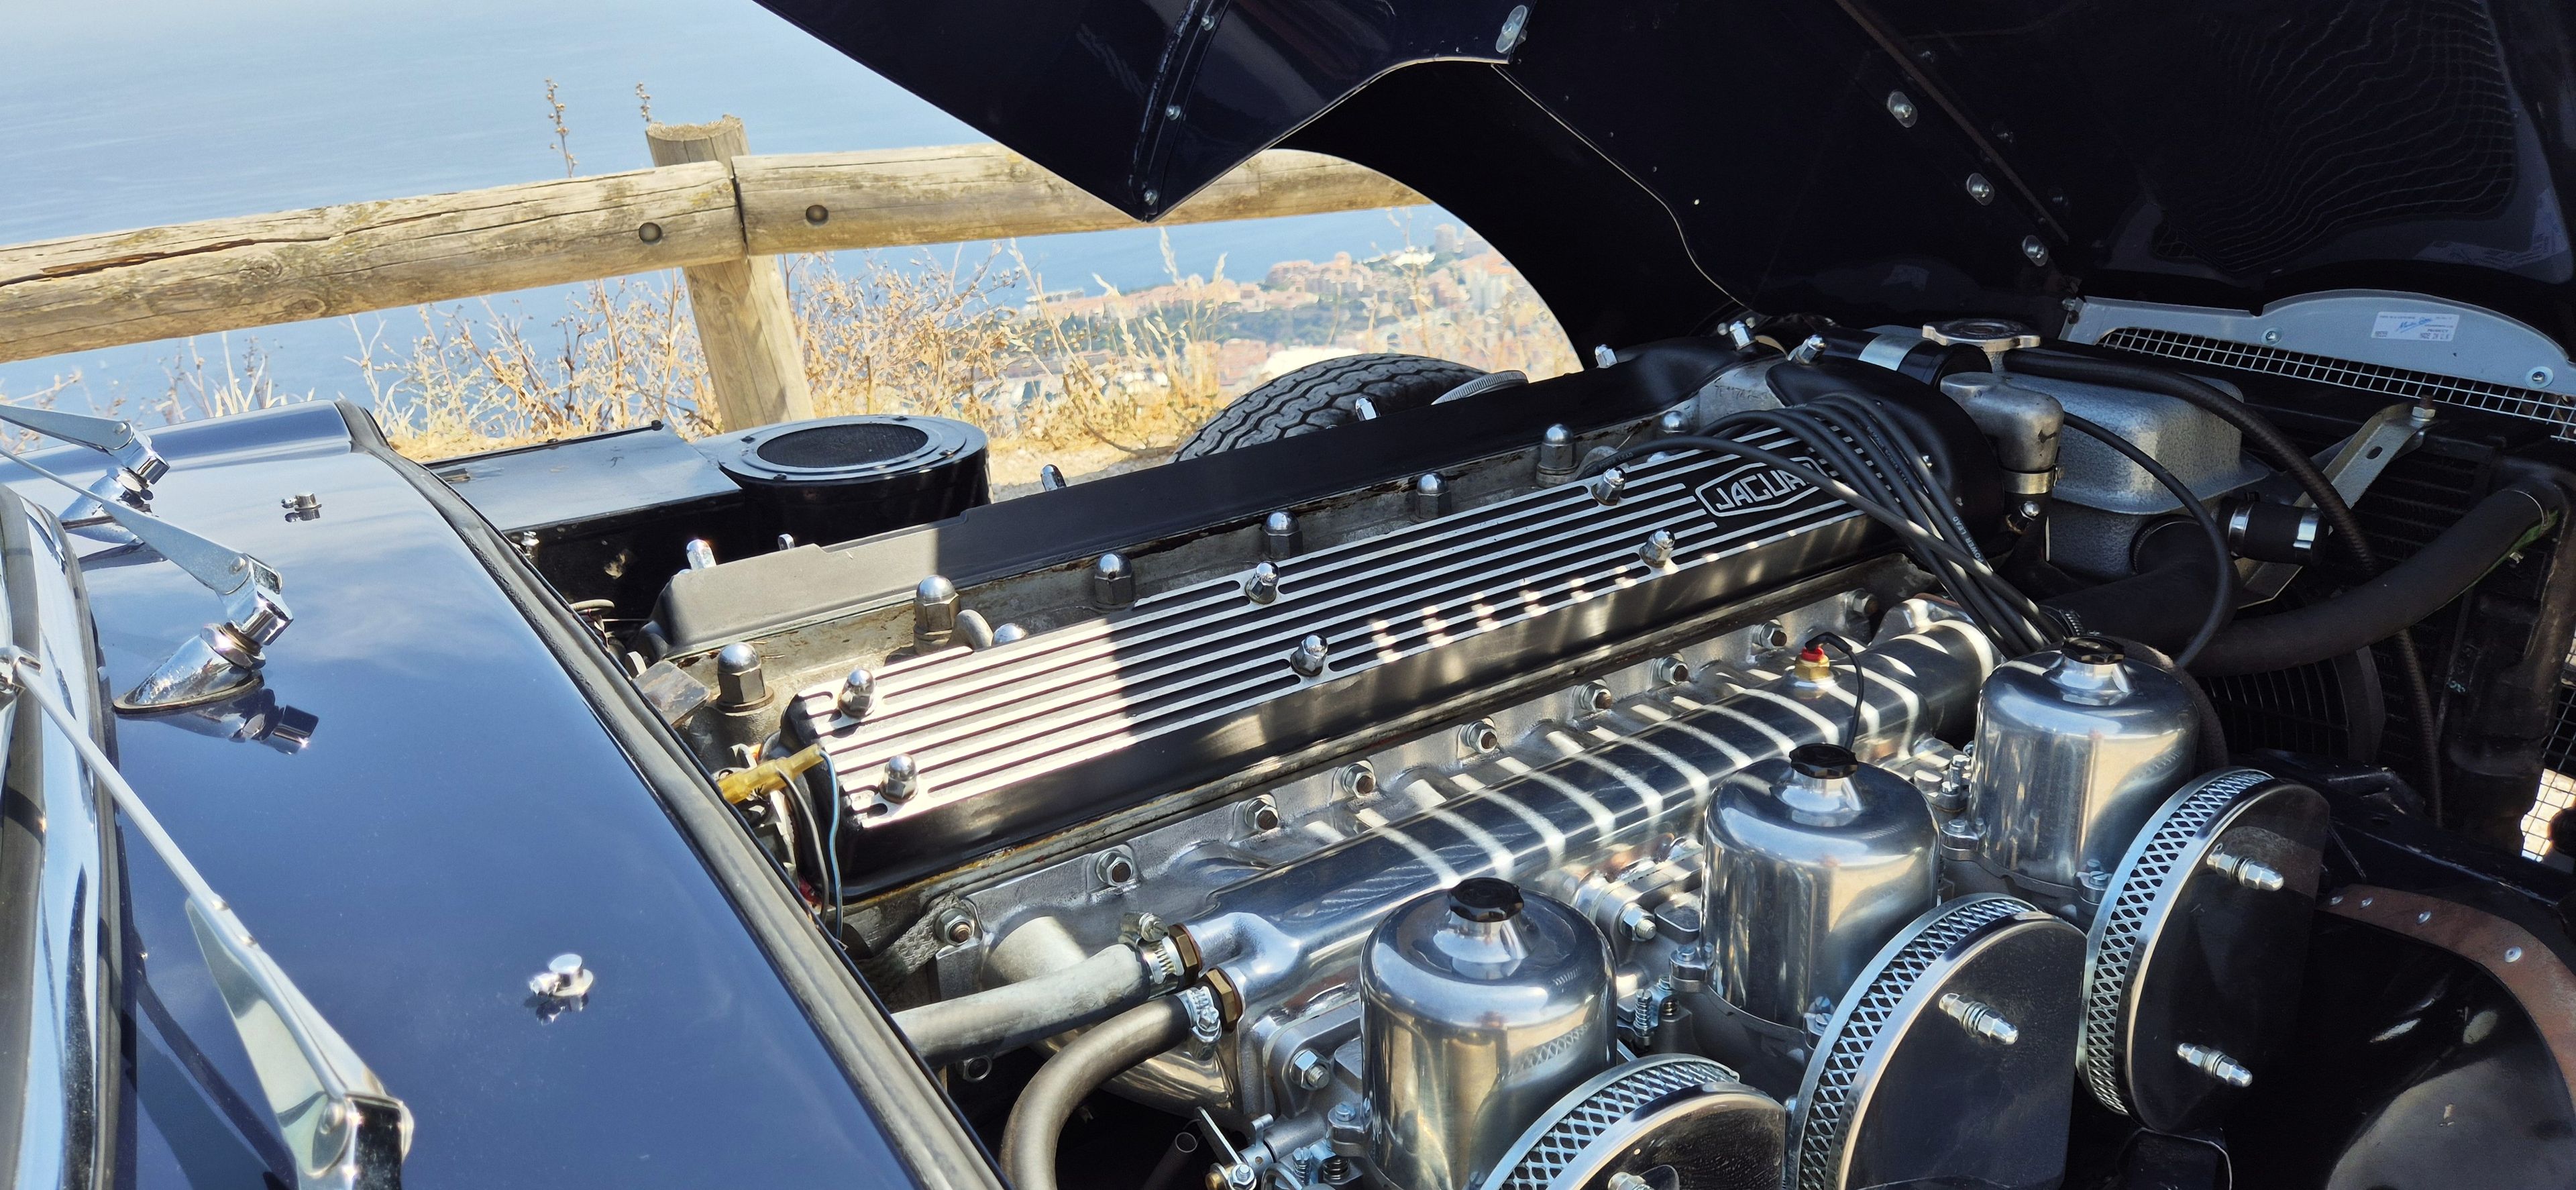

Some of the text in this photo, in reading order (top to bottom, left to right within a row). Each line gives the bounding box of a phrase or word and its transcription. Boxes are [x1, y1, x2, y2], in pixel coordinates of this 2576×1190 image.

[1715, 463, 1813, 510] JAGUA
[1953, 516, 1984, 562] POWER LEAD
